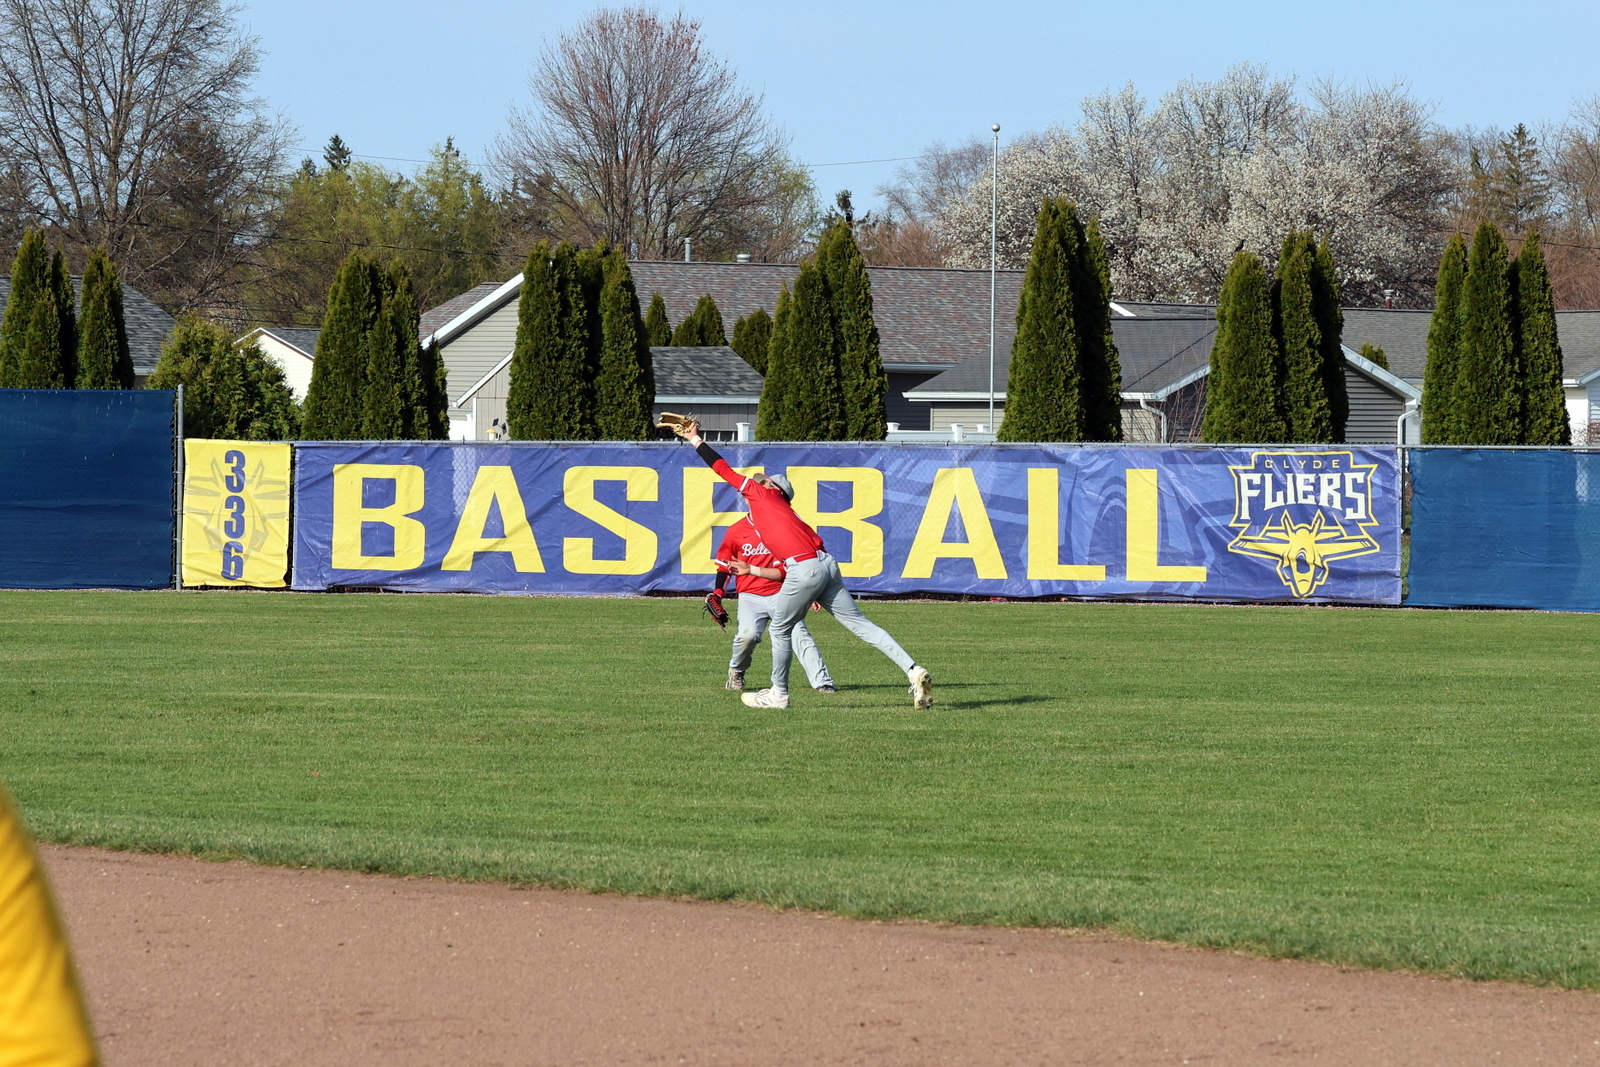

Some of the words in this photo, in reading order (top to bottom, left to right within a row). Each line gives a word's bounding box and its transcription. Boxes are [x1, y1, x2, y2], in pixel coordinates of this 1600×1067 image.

[1265, 459, 1340, 469] CLYDE
[221, 449, 246, 581] 336
[1239, 471, 1367, 520] FLIERS
